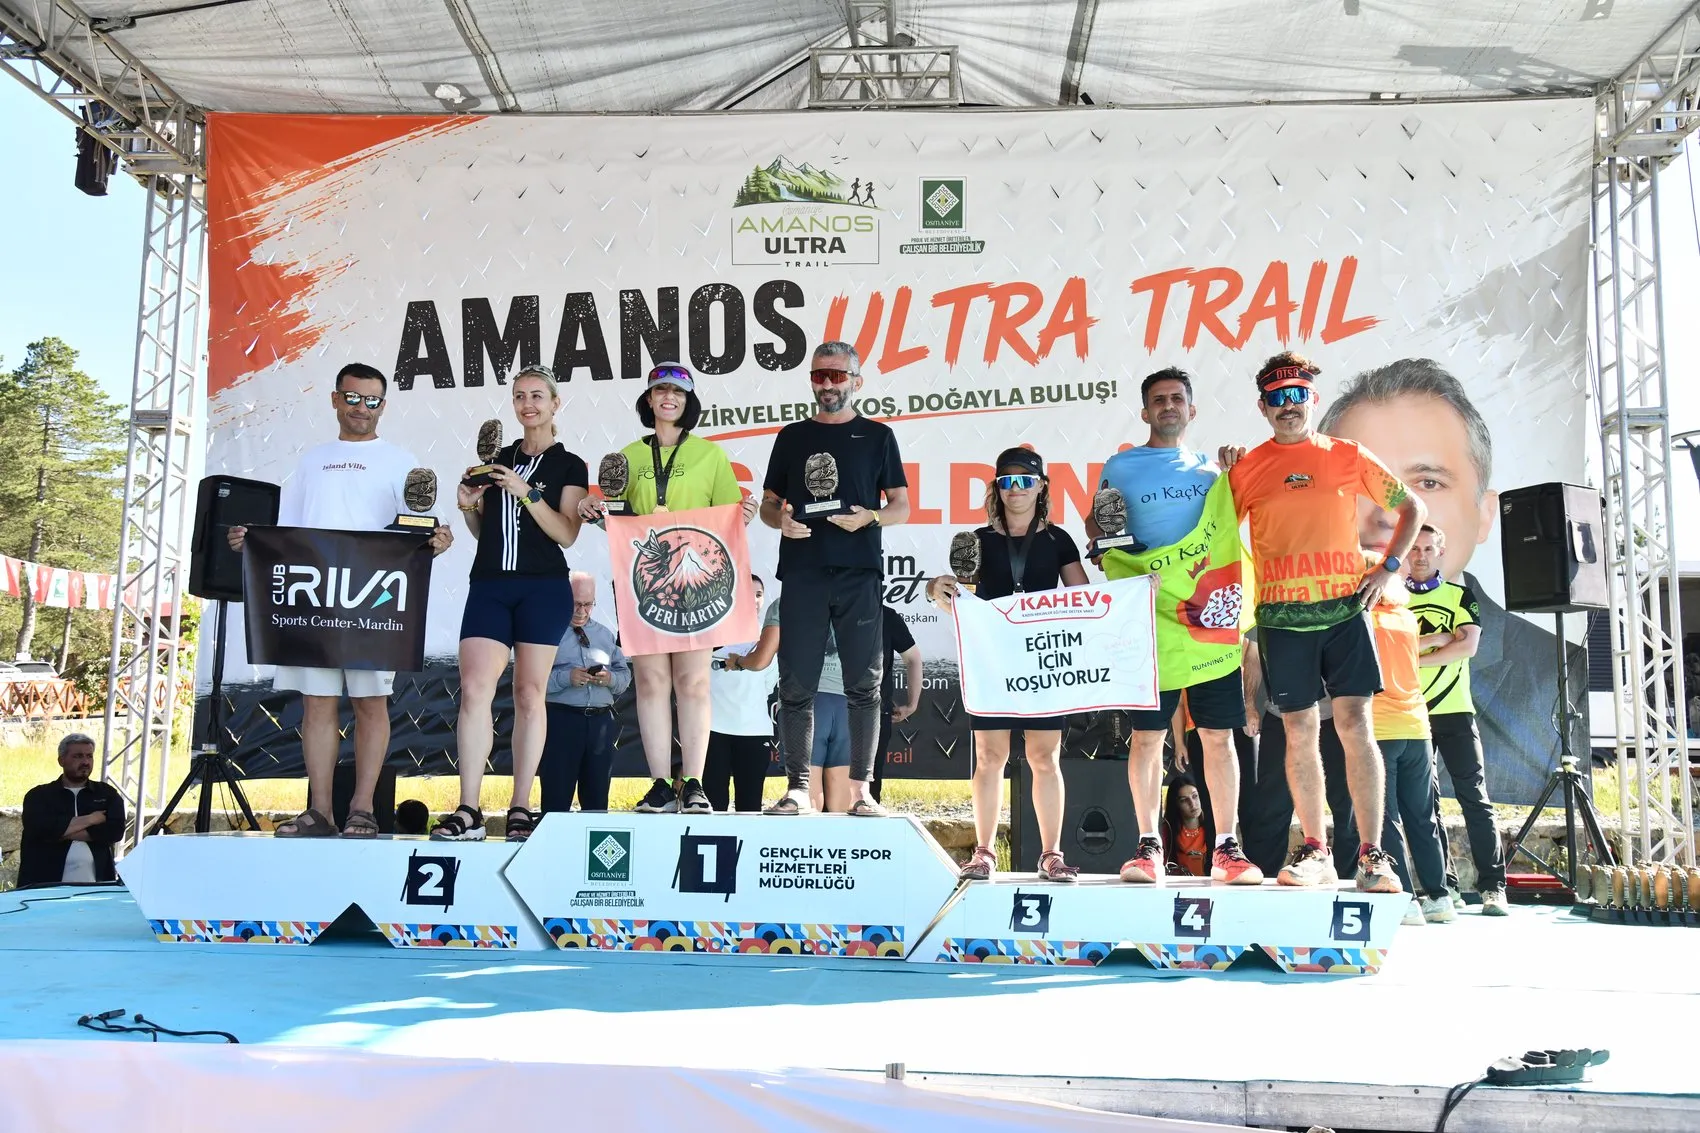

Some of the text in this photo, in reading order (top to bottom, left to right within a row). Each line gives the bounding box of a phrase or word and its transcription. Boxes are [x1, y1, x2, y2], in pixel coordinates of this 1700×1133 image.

[737, 215, 874, 233] AMANOS
[764, 236, 847, 255] ULTRA
[394, 255, 1381, 391] AMANOS ULTRA TRAIL
[698, 401, 818, 428] ZİRVELER
[908, 386, 1026, 412] DOĞAYLA
[1030, 380, 1118, 405] BULUŞ!
[348, 462, 367, 471] Ville
[1162, 484, 1209, 501] KaçKa
[1263, 551, 1356, 584] AMANOS
[272, 564, 408, 611] CLUB RIVA
[645, 596, 728, 626] PERİ KARTİN
[1020, 591, 1100, 610] KAHEV
[272, 613, 404, 631] Sports Center-Mardin
[1025, 629, 1082, 652] EĞİTİM
[1038, 650, 1072, 672] İÇİN
[1191, 652, 1234, 672] RUNNING TO
[1006, 668, 1111, 693] KOŞUYORUZ
[697, 844, 717, 883] 1
[759, 845, 892, 861] GENÇLİK VE SPOR
[590, 871, 627, 879] OSMANİYE
[759, 859, 847, 874] HİZMETLERİ
[418, 863, 444, 897] 2
[759, 875, 855, 890] MÜDÜRLÜĞÜ
[1021, 900, 1041, 926] 3
[1181, 904, 1205, 930] 4
[1341, 907, 1363, 935] 5
